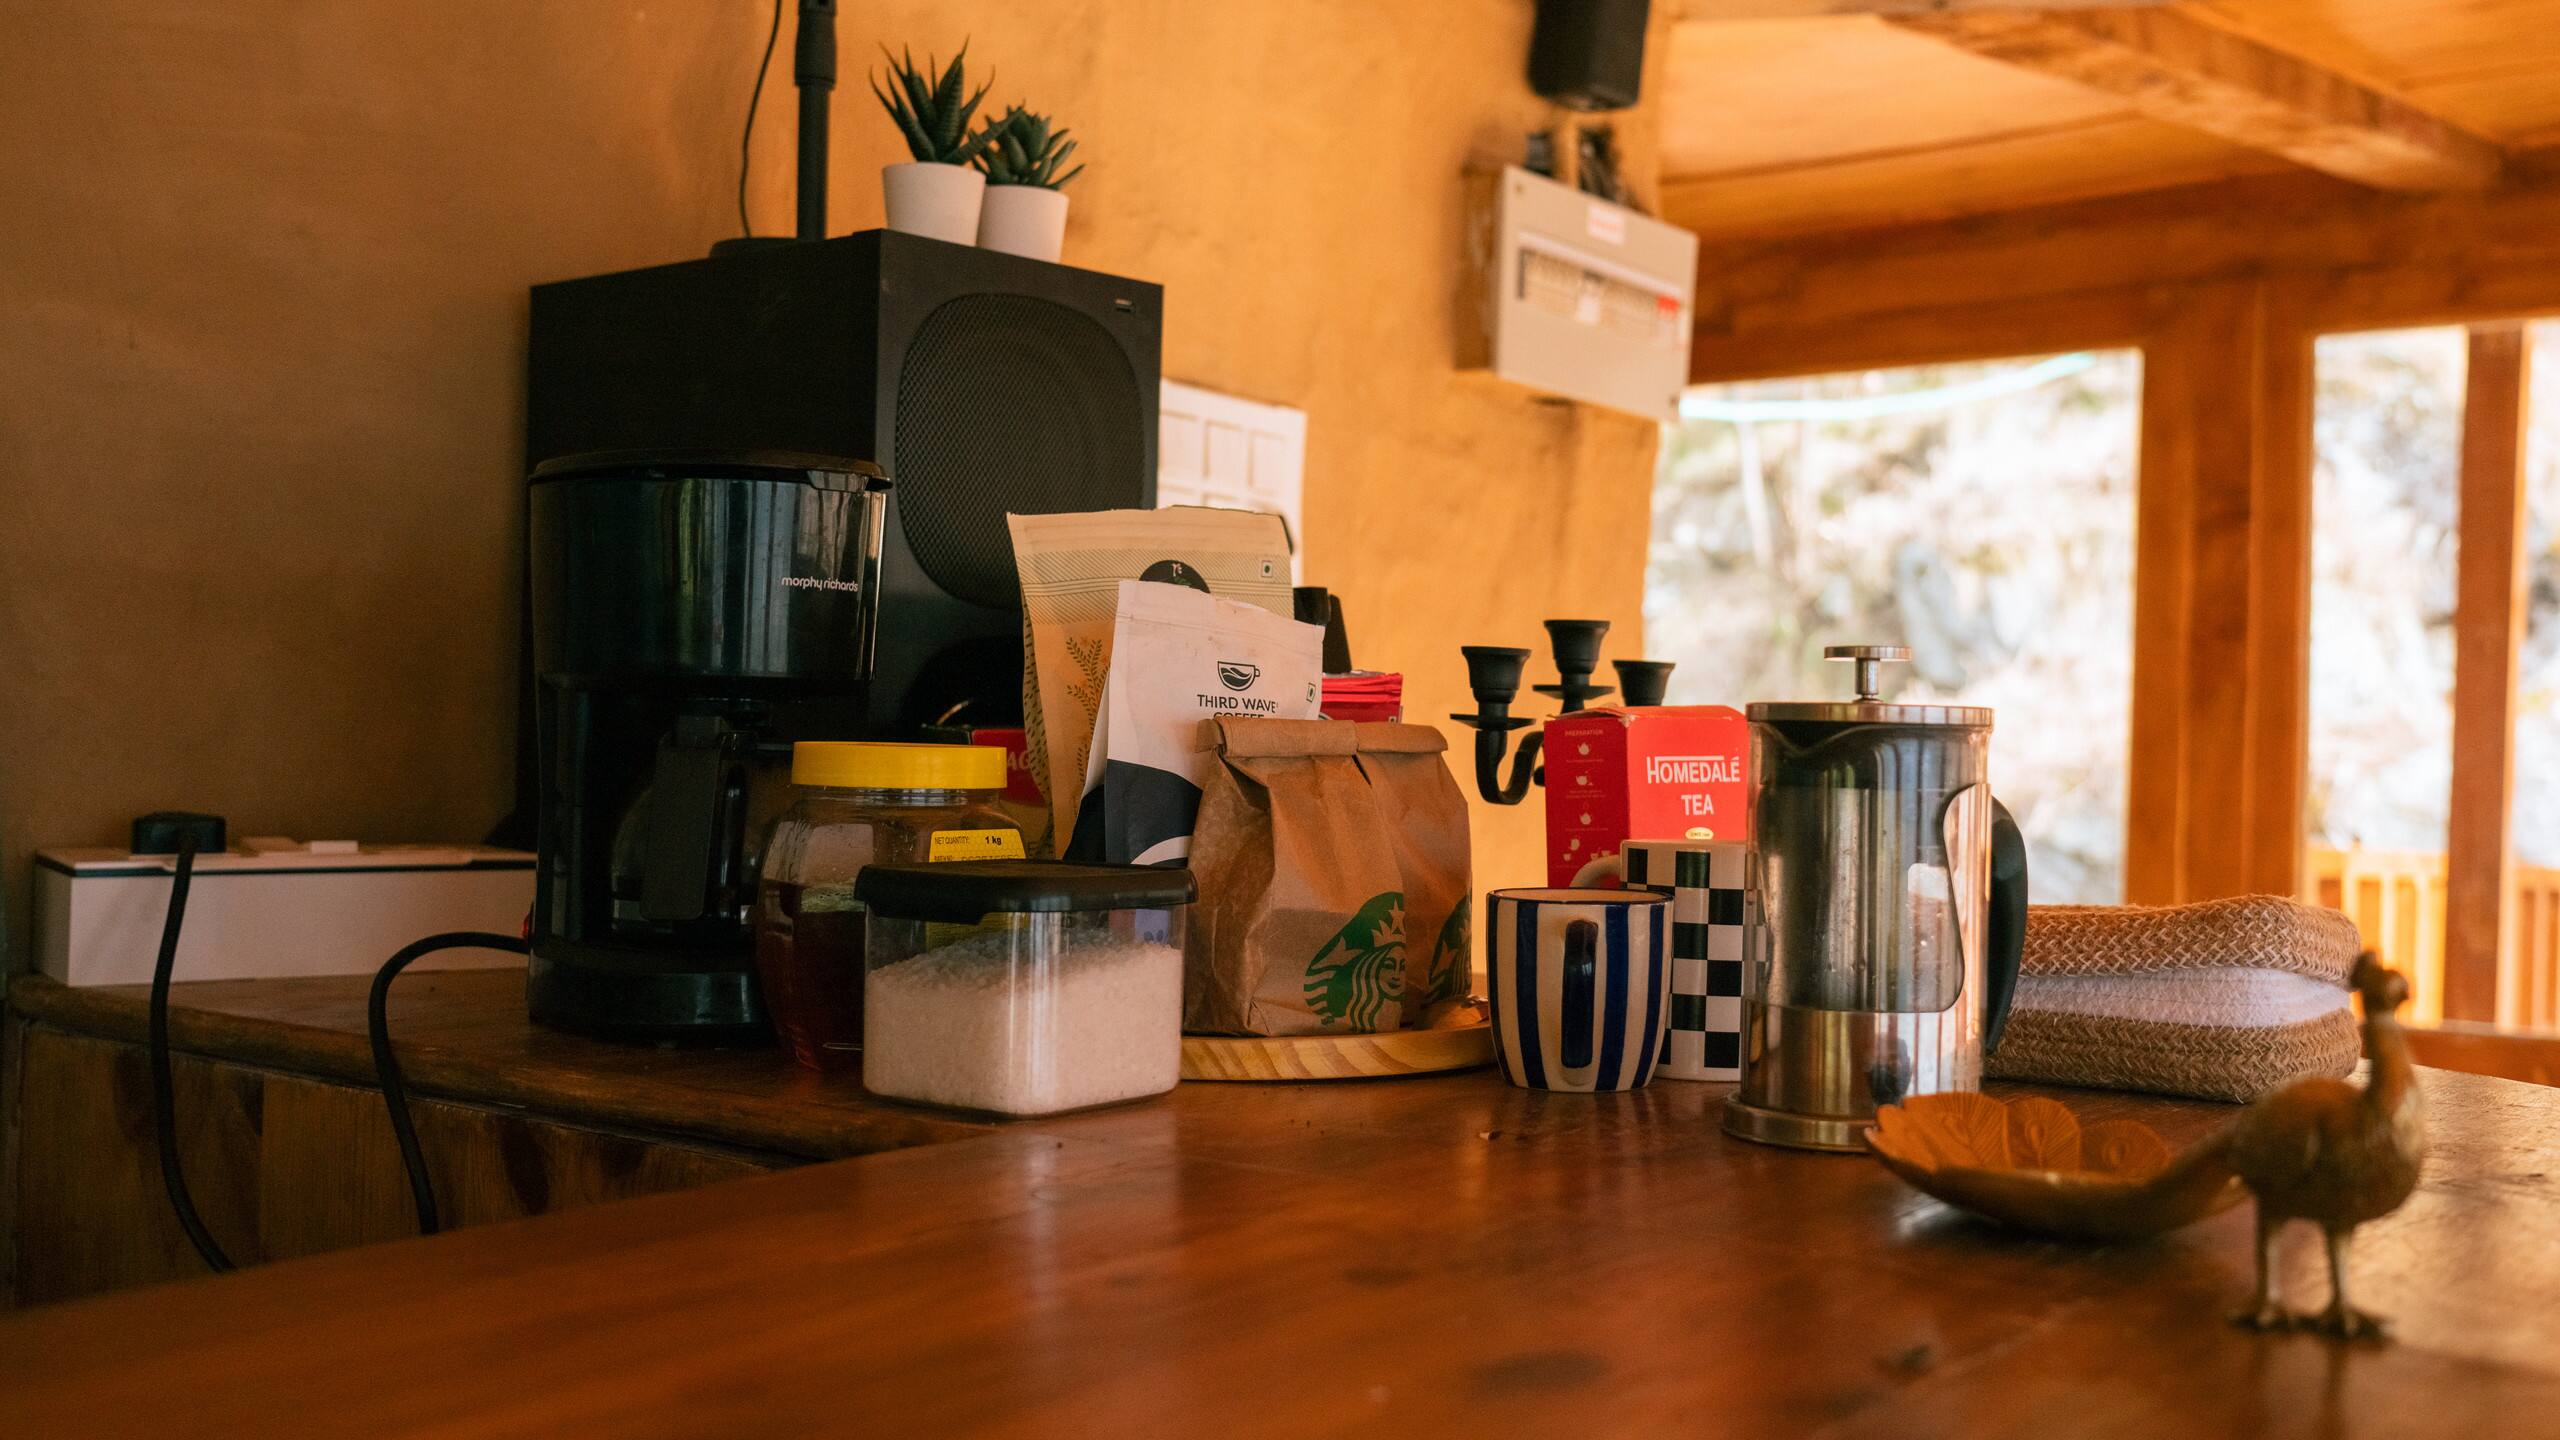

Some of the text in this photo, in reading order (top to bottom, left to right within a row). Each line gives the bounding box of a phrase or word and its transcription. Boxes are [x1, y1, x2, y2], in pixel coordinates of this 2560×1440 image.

[781, 576, 859, 592] morphy richards
[1197, 694, 1276, 714] THIRD WAVE
[1646, 755, 1740, 784] HOMEDALÉ
[1681, 794, 1715, 816] TEA
[934, 837, 945, 845] NET
[985, 835, 1002, 846] 1 kg
